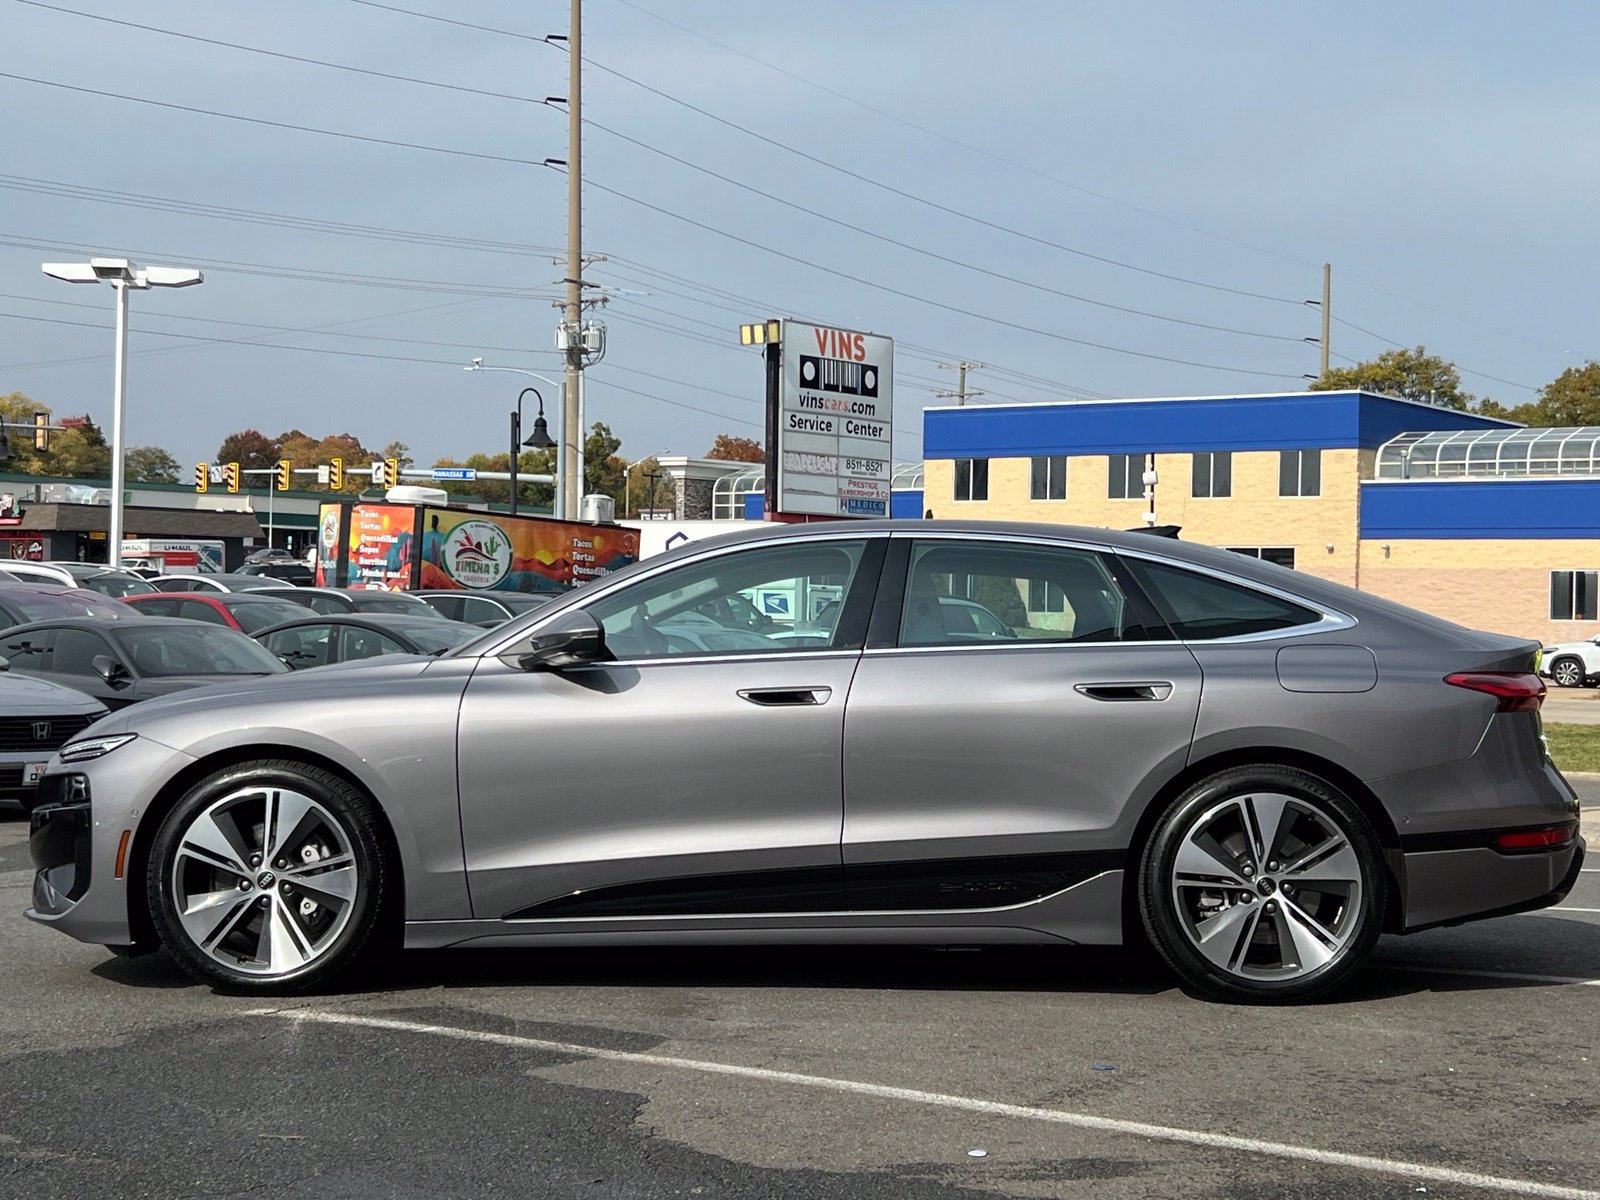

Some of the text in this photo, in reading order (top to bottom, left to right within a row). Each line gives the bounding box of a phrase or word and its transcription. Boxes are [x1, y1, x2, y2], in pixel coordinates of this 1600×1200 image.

[815, 328, 865, 362] VINS
[799, 391, 875, 416] vinscars.com
[789, 414, 883, 438] Service Center
[846, 459, 883, 473] 8511-8521
[432, 470, 463, 478] MANASSAS
[848, 479, 879, 490] PRESTIGE
[850, 500, 884, 510] MEDICO
[360, 510, 379, 518] Tacos
[360, 521, 381, 529] Tortas
[360, 533, 399, 543] Quesadillas
[573, 539, 592, 548] Tacos
[572, 551, 595, 561] Tortas
[456, 561, 500, 576] XIMENA'S
[571, 578, 589, 588] Sop
